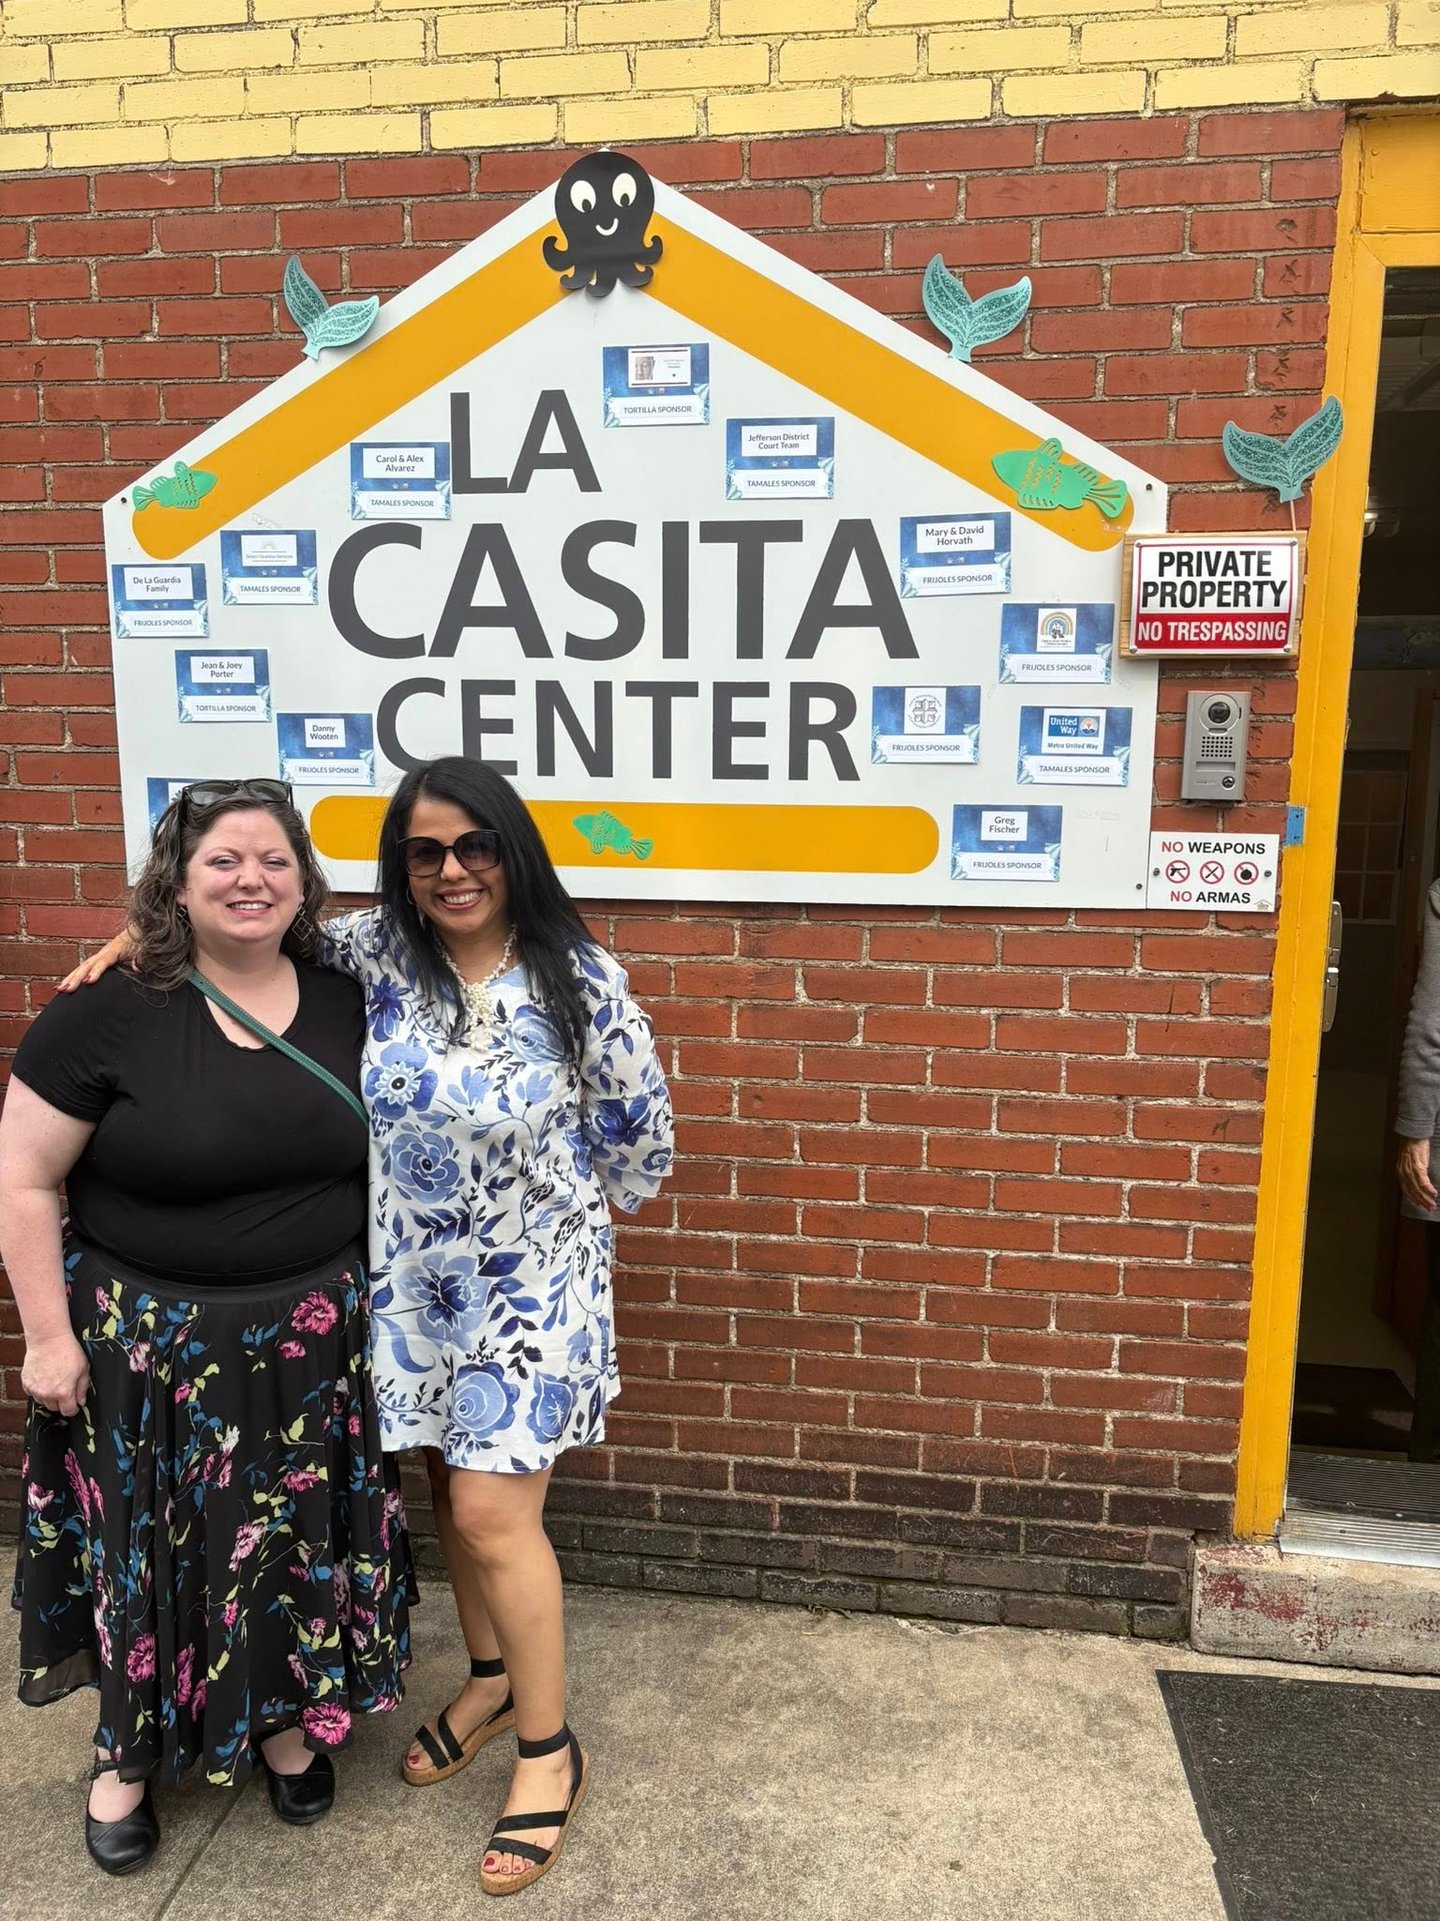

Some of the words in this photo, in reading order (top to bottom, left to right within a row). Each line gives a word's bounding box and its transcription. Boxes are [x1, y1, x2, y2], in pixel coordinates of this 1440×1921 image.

[450, 389, 602, 494] LA
[748, 434, 781, 442] Jefferson
[782, 432, 810, 441] District
[758, 442, 779, 450] Court
[376, 454, 398, 463] Carol
[398, 455, 405, 463] &
[406, 454, 424, 463] Alex
[385, 464, 415, 472] Alvarez
[926, 528, 948, 538] Mary
[950, 527, 957, 535] &
[959, 525, 984, 535] David
[937, 536, 973, 546] Horvath
[1158, 551, 1272, 577] PRIVATE
[153, 576, 181, 584] Guardia
[923, 576, 956, 584] FRIJOLES
[957, 574, 993, 582] SPONSOR
[146, 585, 169, 593] Family
[328, 518, 919, 661] CASITA
[1142, 580, 1287, 608] PROPERTY
[1138, 621, 1162, 642] NO
[1168, 621, 1287, 641] TRESPASSING
[226, 662, 242, 670] Joey
[1056, 664, 1092, 672] SPONSOR
[210, 670, 234, 678] Porter
[1050, 717, 1078, 726] United
[312, 725, 336, 733] Danny
[376, 676, 860, 781] CENTER
[1060, 726, 1077, 736] Way
[925, 744, 960, 752] SPONSOR
[994, 816, 1015, 825] Greg
[989, 825, 1020, 833] Fischer
[1162, 841, 1184, 853] NO
[1188, 842, 1266, 854] WEAPONS
[1170, 891, 1192, 903] NO
[1195, 892, 1251, 903] ARMAS
